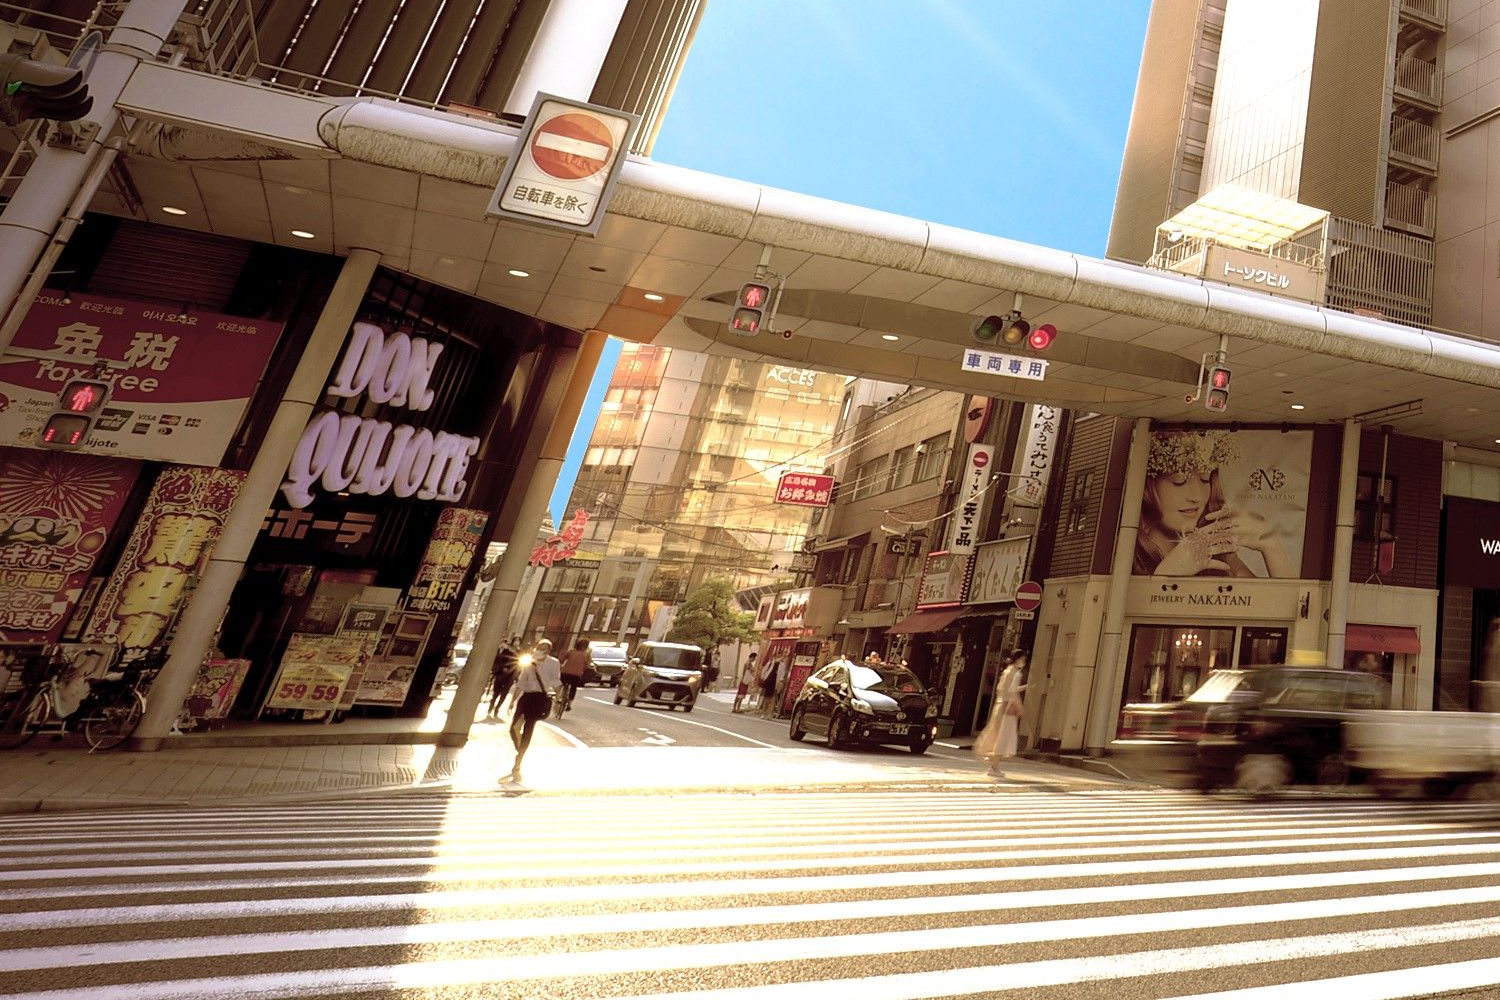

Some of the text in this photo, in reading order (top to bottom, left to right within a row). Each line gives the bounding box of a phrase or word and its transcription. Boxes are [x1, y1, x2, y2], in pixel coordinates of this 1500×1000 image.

[513, 185, 589, 215] 自転車を除く
[1224, 261, 1290, 289] トーソクビル
[53, 321, 180, 371] 免税
[327, 321, 445, 412] DON
[966, 353, 1043, 378] 車両専用
[280, 408, 481, 509] QUIJOTE
[970, 469, 982, 498] ラーメン
[1257, 493, 1296, 502] NAKATANI
[955, 502, 977, 547] 天下一品
[0, 543, 93, 572] キホーテ
[1150, 594, 1252, 606] JEWELRY NAKATANI
[279, 683, 340, 700] 59 59
